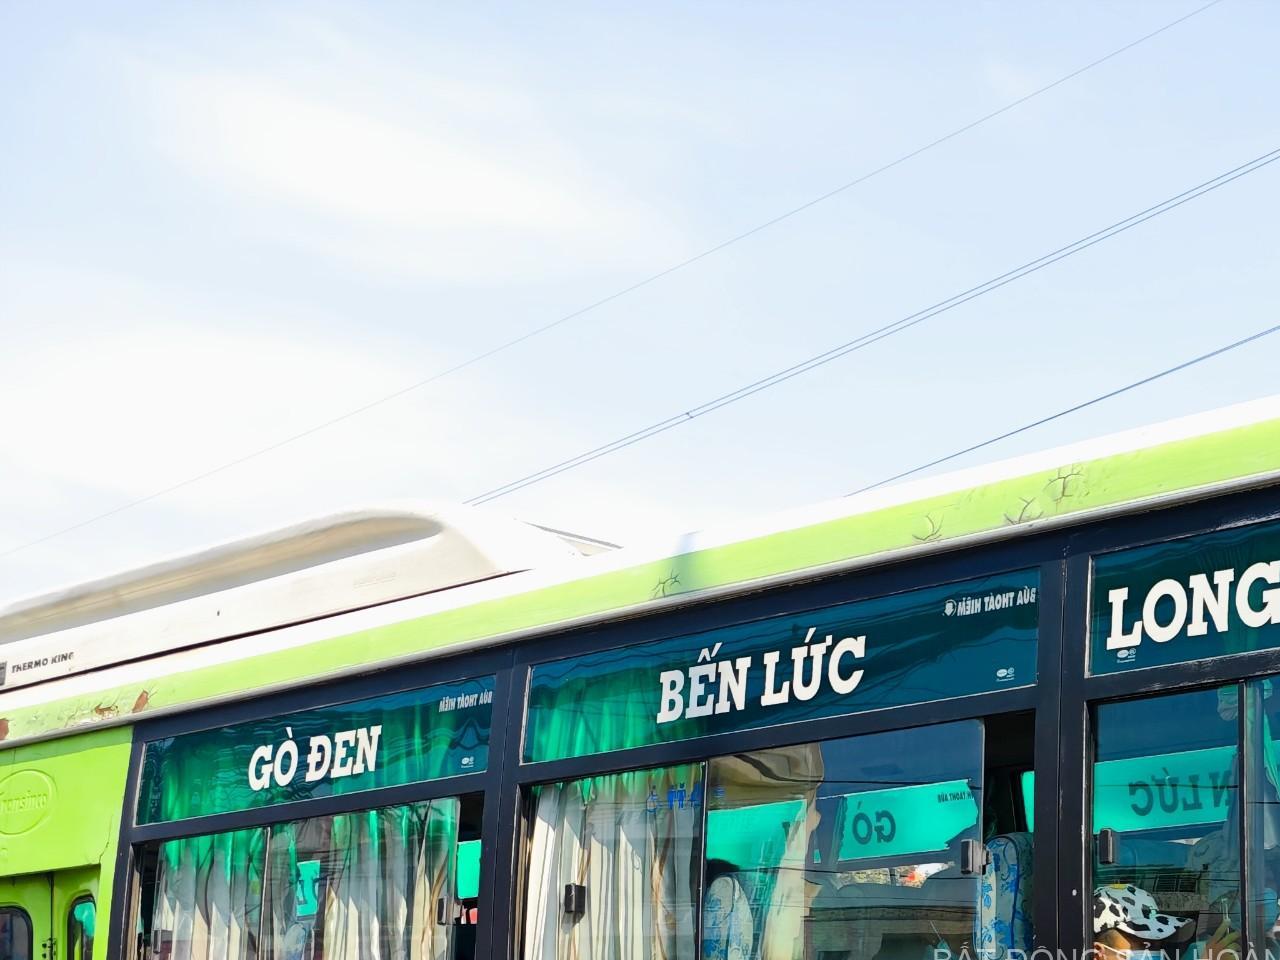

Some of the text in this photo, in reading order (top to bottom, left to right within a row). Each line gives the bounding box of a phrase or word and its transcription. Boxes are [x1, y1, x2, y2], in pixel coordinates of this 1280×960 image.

[11, 657, 49, 673] THERMO
[656, 627, 866, 724] BẾN LỨC
[248, 725, 382, 791] GÒ ĐEN
